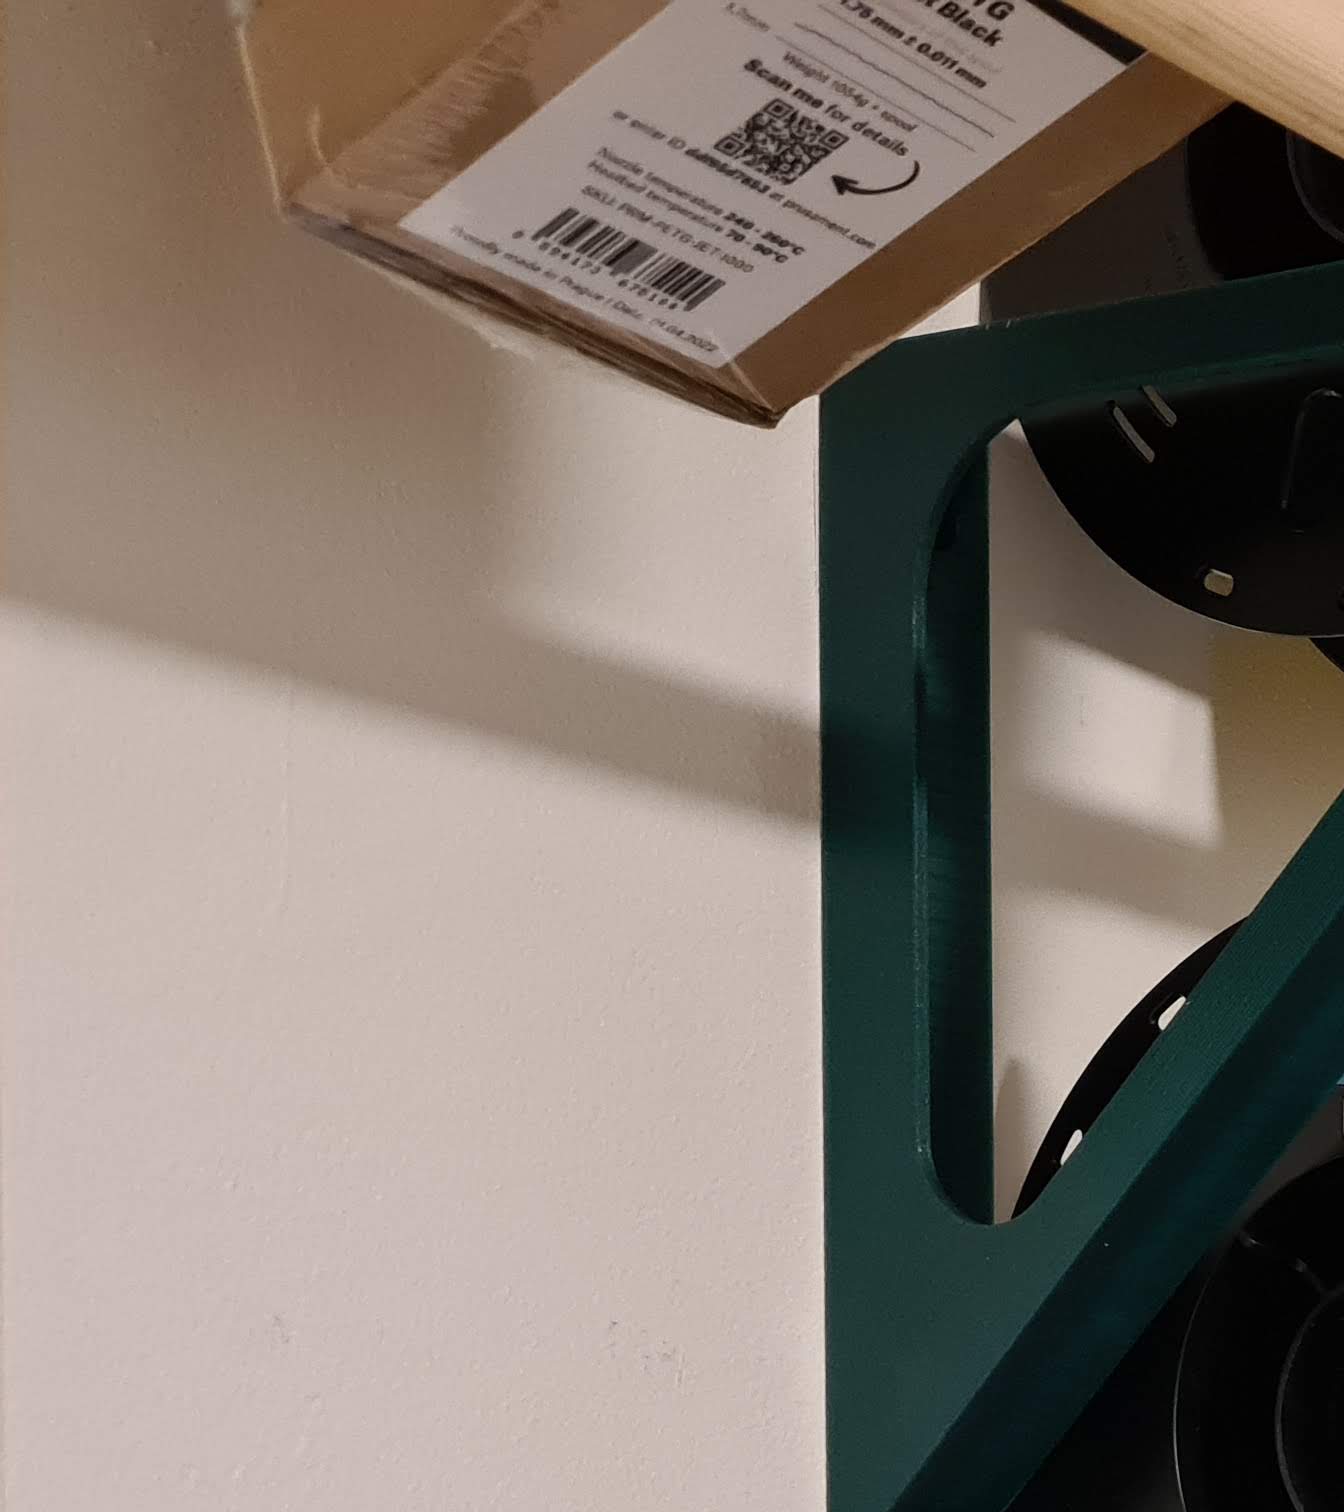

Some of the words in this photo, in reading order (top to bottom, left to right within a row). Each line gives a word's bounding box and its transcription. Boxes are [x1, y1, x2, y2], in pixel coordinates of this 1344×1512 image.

[870, 16, 905, 39] mm
[916, 43, 959, 69] 0.011
[954, 67, 987, 89] mm
[937, 2, 1004, 47] Black
[744, 59, 793, 92] Scan
[792, 88, 824, 109] me
[824, 104, 851, 123] for
[851, 122, 908, 156] details
[645, 190, 724, 233] temperature
